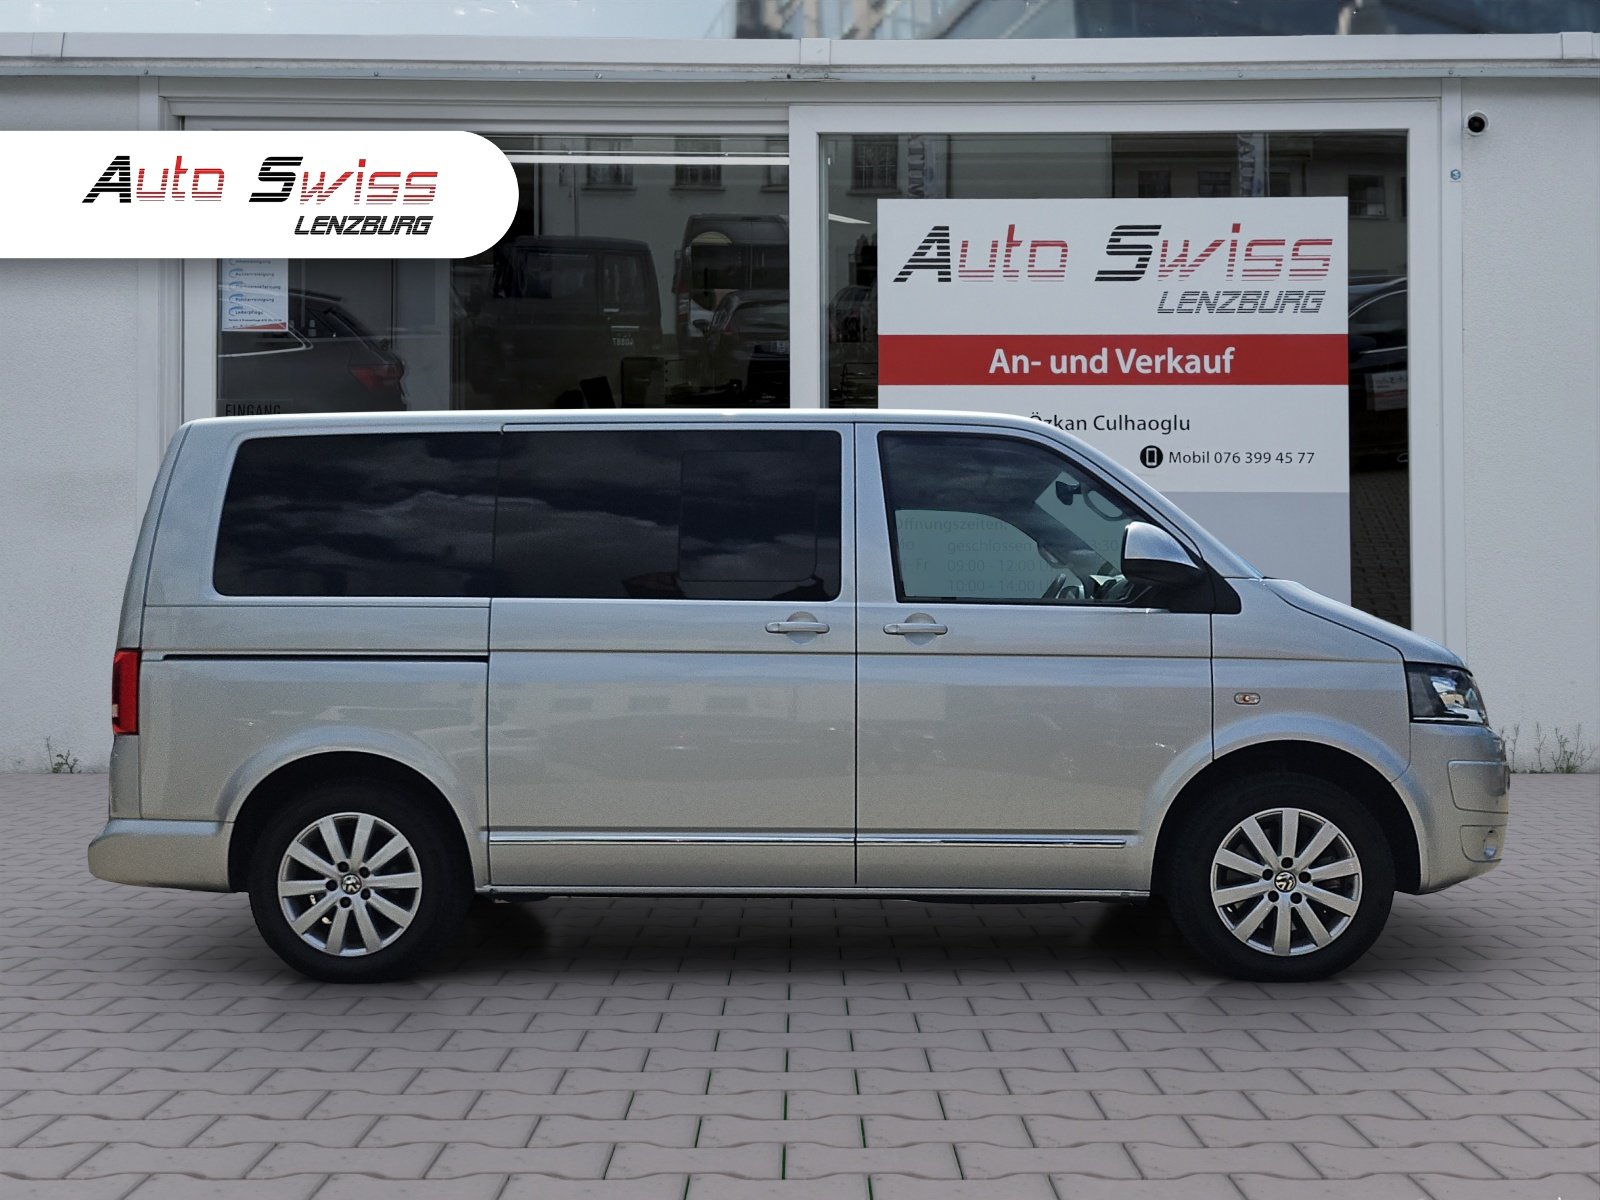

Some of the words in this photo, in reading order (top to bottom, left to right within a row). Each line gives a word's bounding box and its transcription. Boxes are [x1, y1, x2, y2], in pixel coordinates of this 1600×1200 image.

[893, 224, 1068, 282] Auto
[1095, 223, 1333, 281] Swiss
[1157, 290, 1326, 314] LENZBURG
[989, 348, 1042, 374] An-
[1050, 347, 1109, 374] und
[1115, 347, 1235, 374] Verkauf
[1093, 414, 1190, 435] Culhaoglu
[1169, 450, 1210, 464] Mobil
[1214, 451, 1241, 464] 076
[1245, 451, 1271, 464] 399
[1275, 451, 1293, 464] 45
[1298, 451, 1315, 464] 77
[947, 539, 1032, 555] geschlossen
